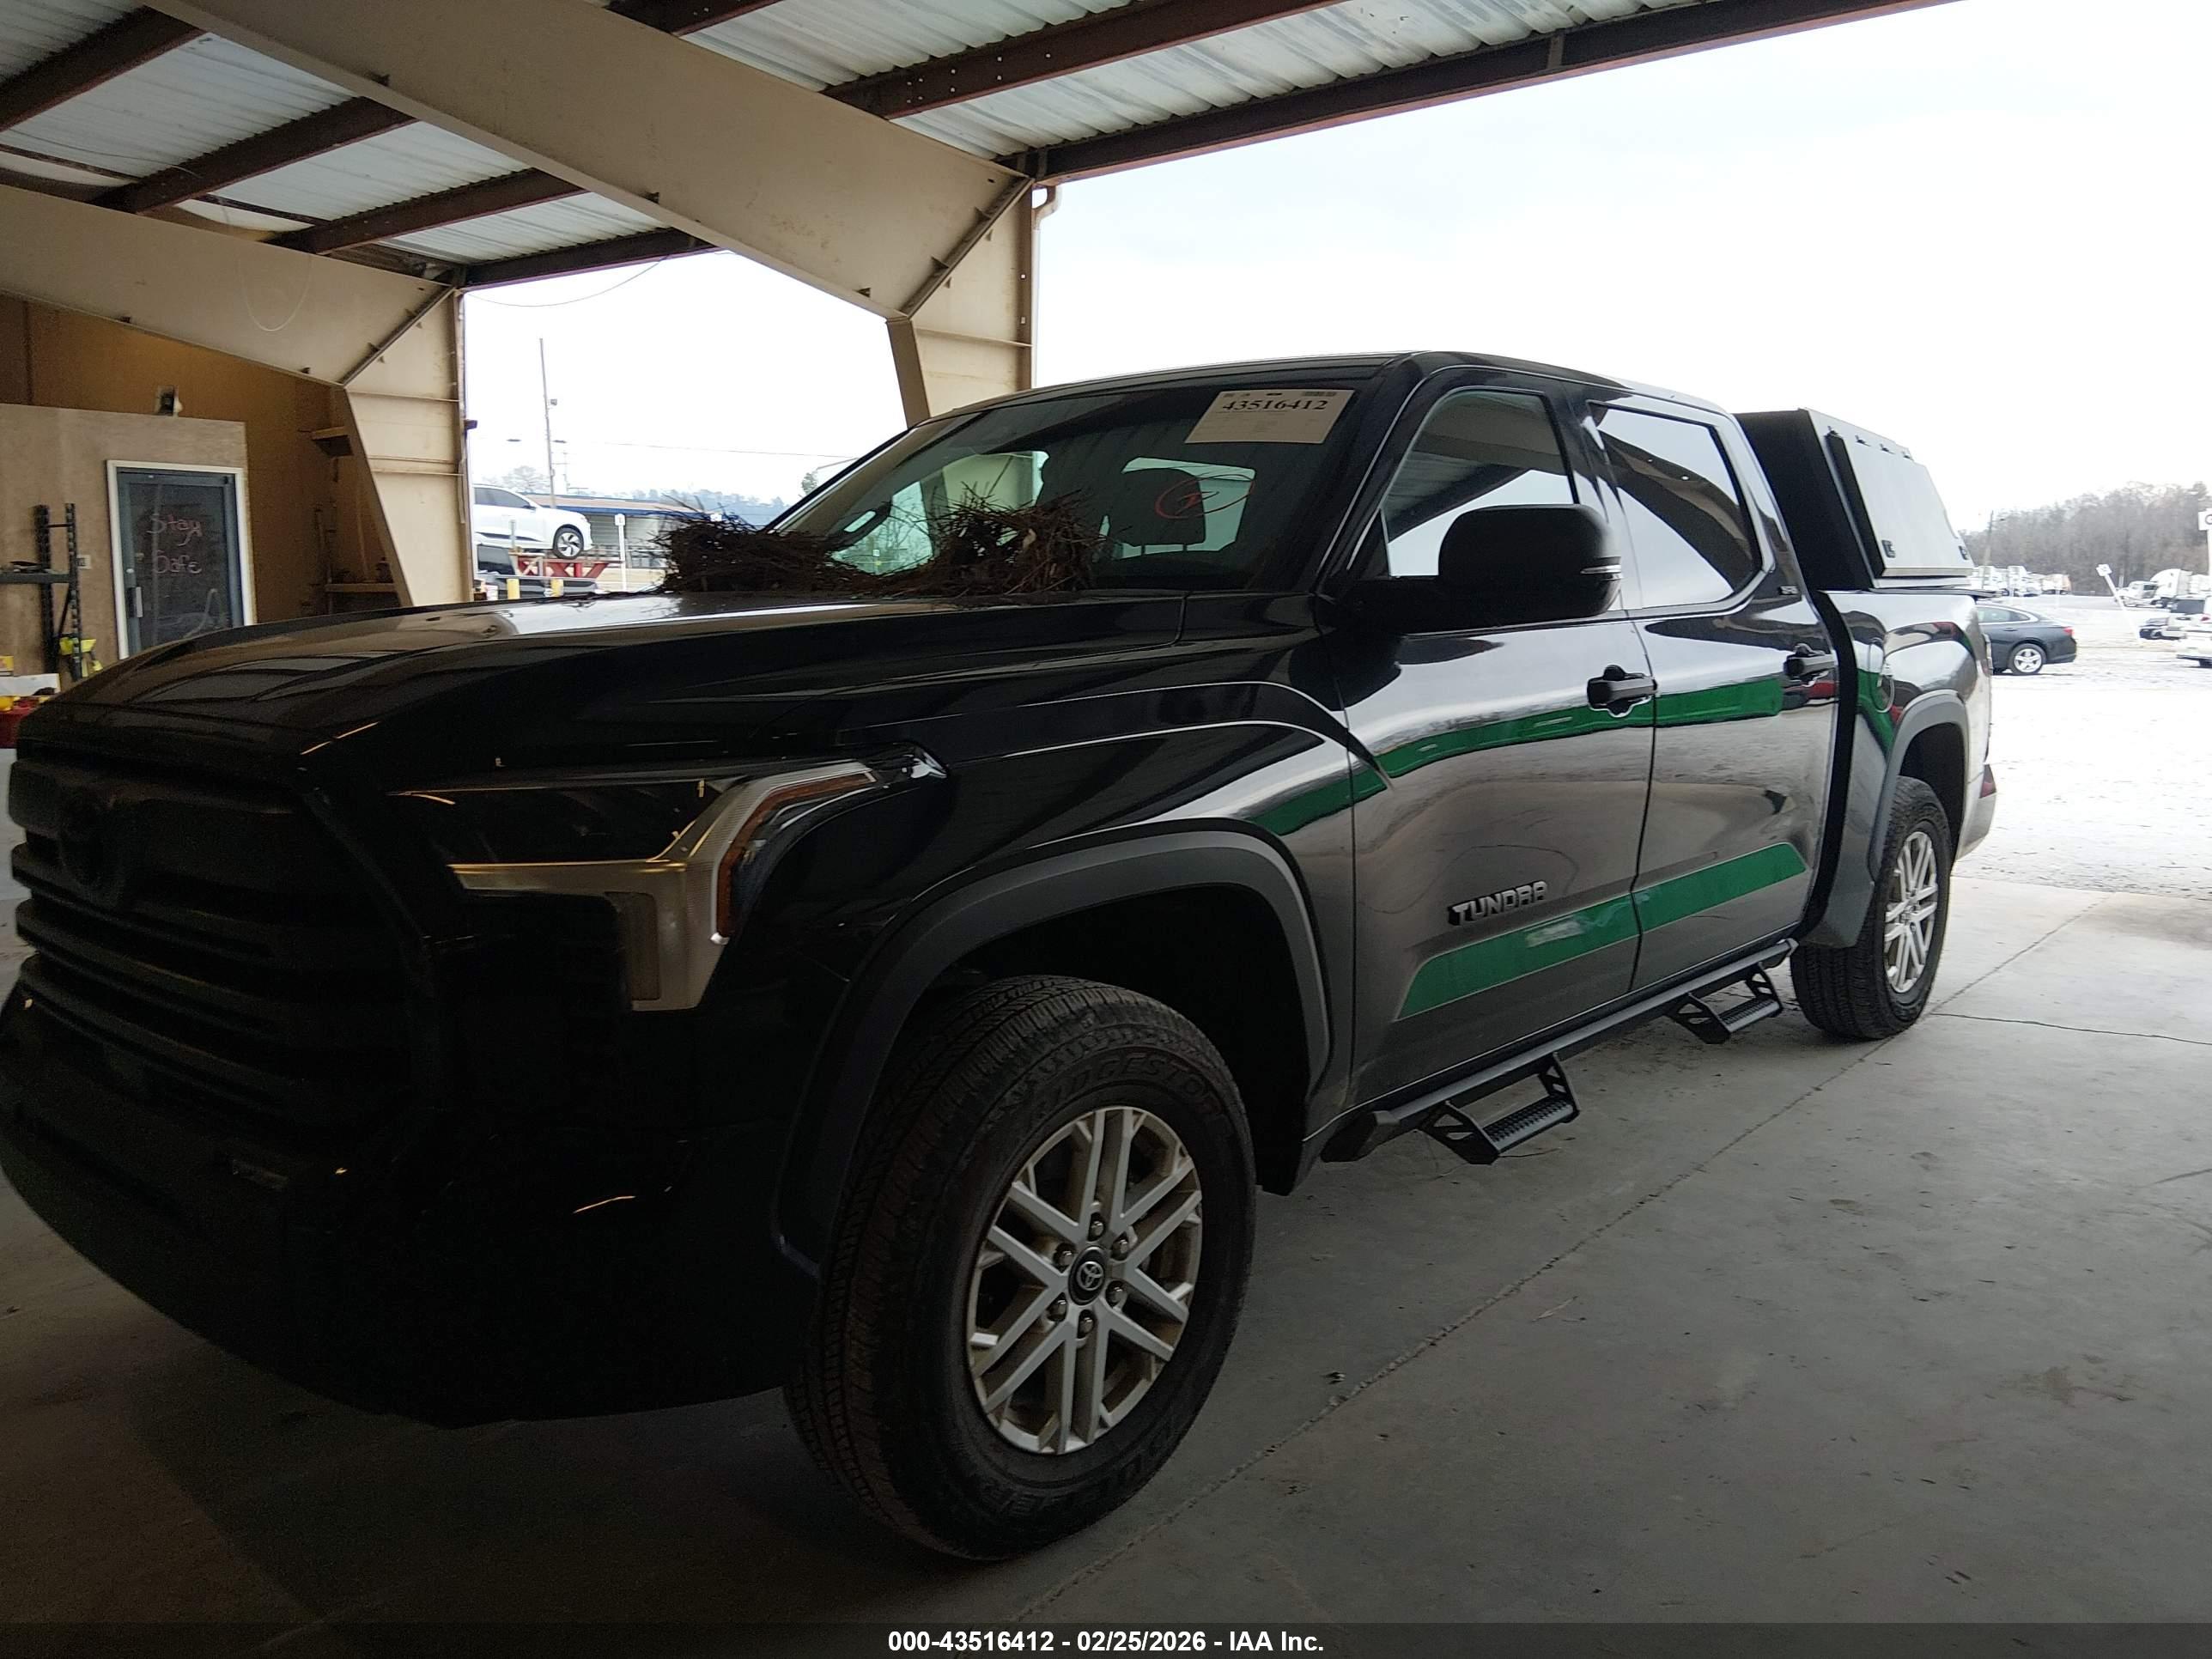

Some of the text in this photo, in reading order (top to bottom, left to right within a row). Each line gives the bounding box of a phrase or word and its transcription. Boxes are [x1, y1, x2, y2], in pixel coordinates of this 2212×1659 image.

[1222, 399, 1327, 410] 43516412
[146, 514, 203, 546] Stay
[153, 550, 203, 574] Safe
[1449, 880, 1548, 927] TUNDRA
